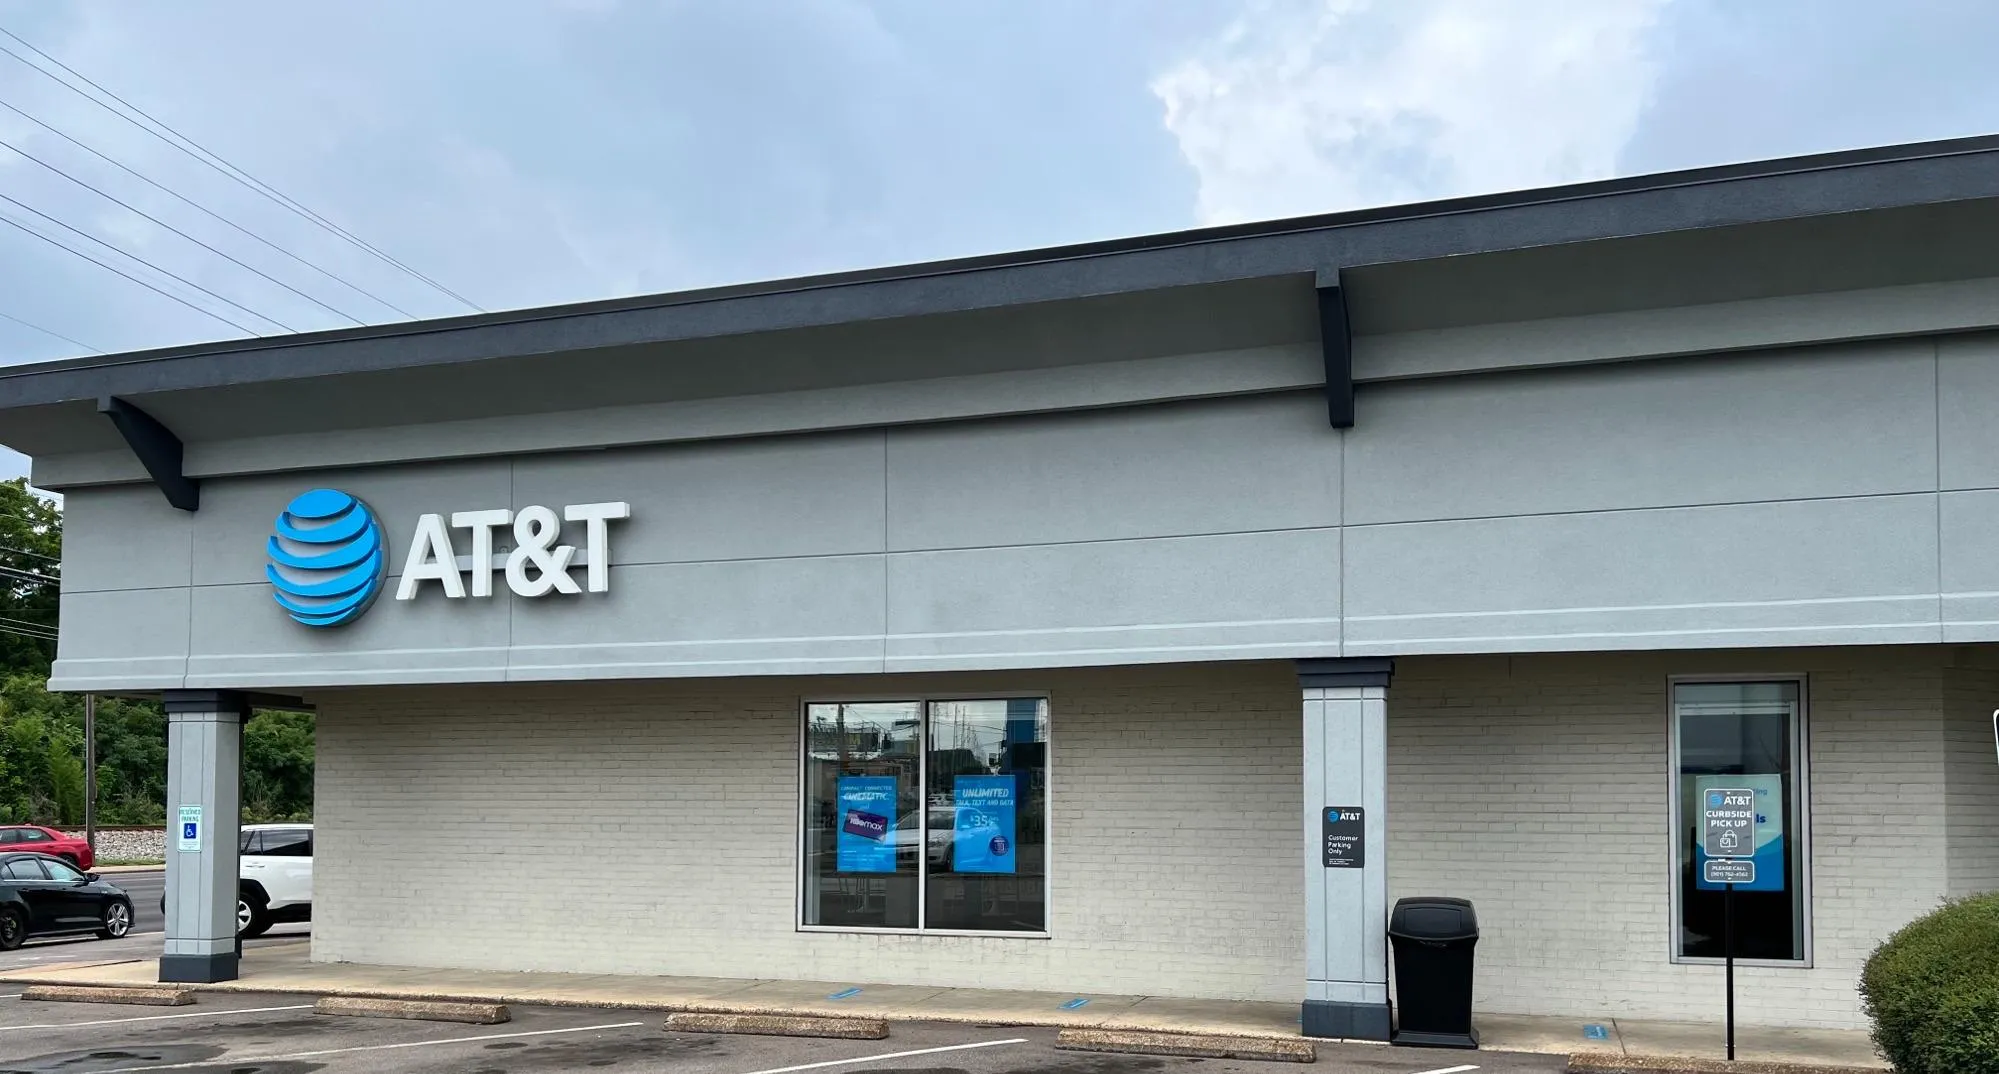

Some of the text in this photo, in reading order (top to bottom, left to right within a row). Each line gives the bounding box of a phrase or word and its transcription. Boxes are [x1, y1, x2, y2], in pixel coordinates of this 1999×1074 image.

[396, 501, 630, 600] AT&T
[962, 788, 1010, 798] UNLIMITED
[1724, 796, 1751, 805] AT&T
[1340, 812, 1360, 821] AT&T
[1710, 820, 1747, 828] PICK UP
[1328, 841, 1352, 849] Parking
